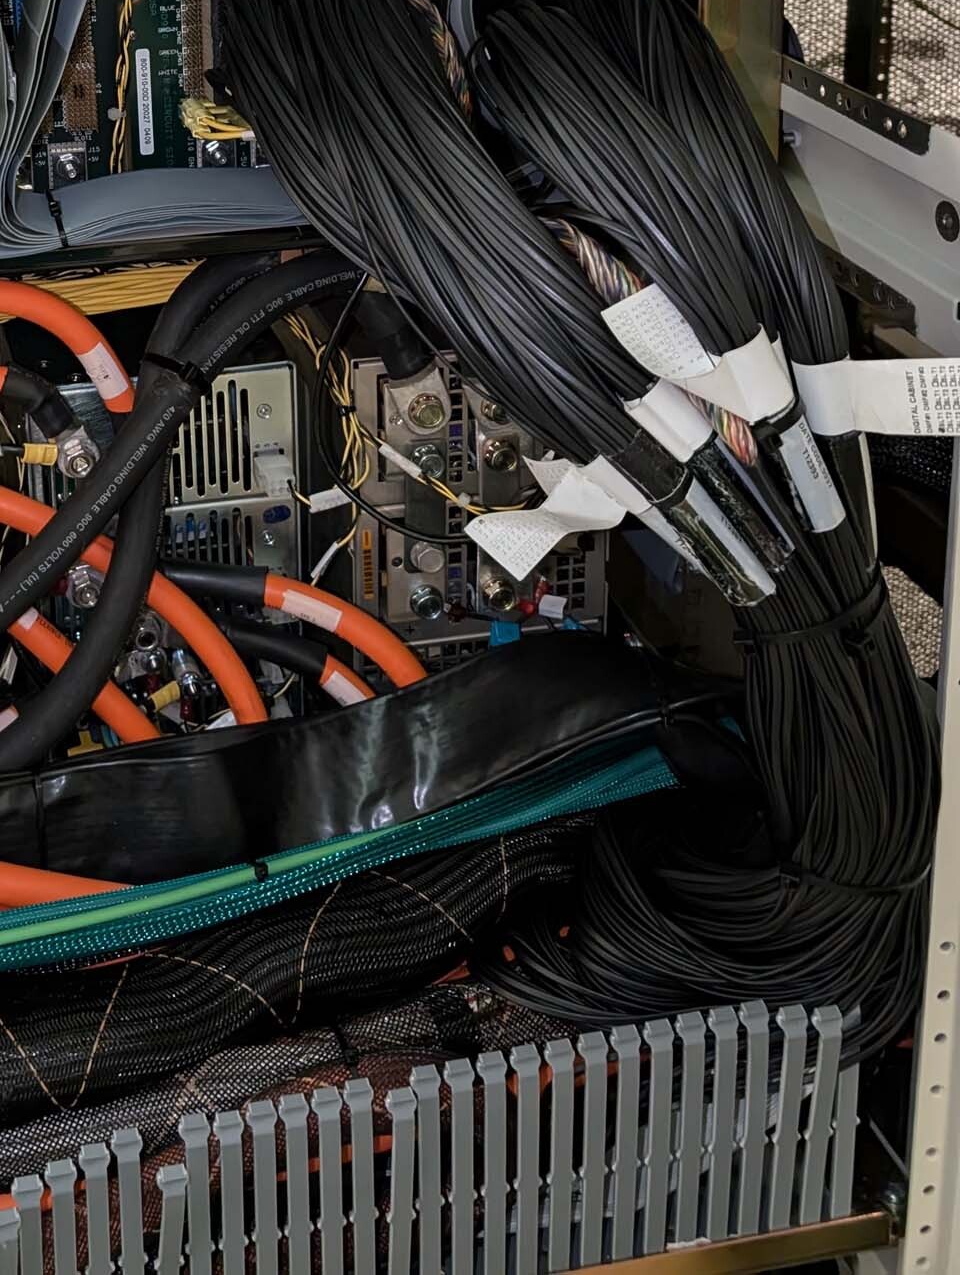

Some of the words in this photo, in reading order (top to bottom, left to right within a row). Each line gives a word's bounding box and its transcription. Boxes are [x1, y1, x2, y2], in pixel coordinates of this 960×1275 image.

[144, 127, 152, 145] 0409
[284, 283, 314, 302] CABLE
[266, 298, 284, 313] 90C
[906, 371, 916, 404] CABINET
[147, 418, 165, 443] AWG
[912, 405, 921, 433] DIGITAL
[114, 444, 149, 486] WELDING
[91, 484, 117, 514] CABLE
[76, 514, 93, 532] 90C
[62, 531, 77, 548] 600
[39, 547, 64, 574] VOLTS
